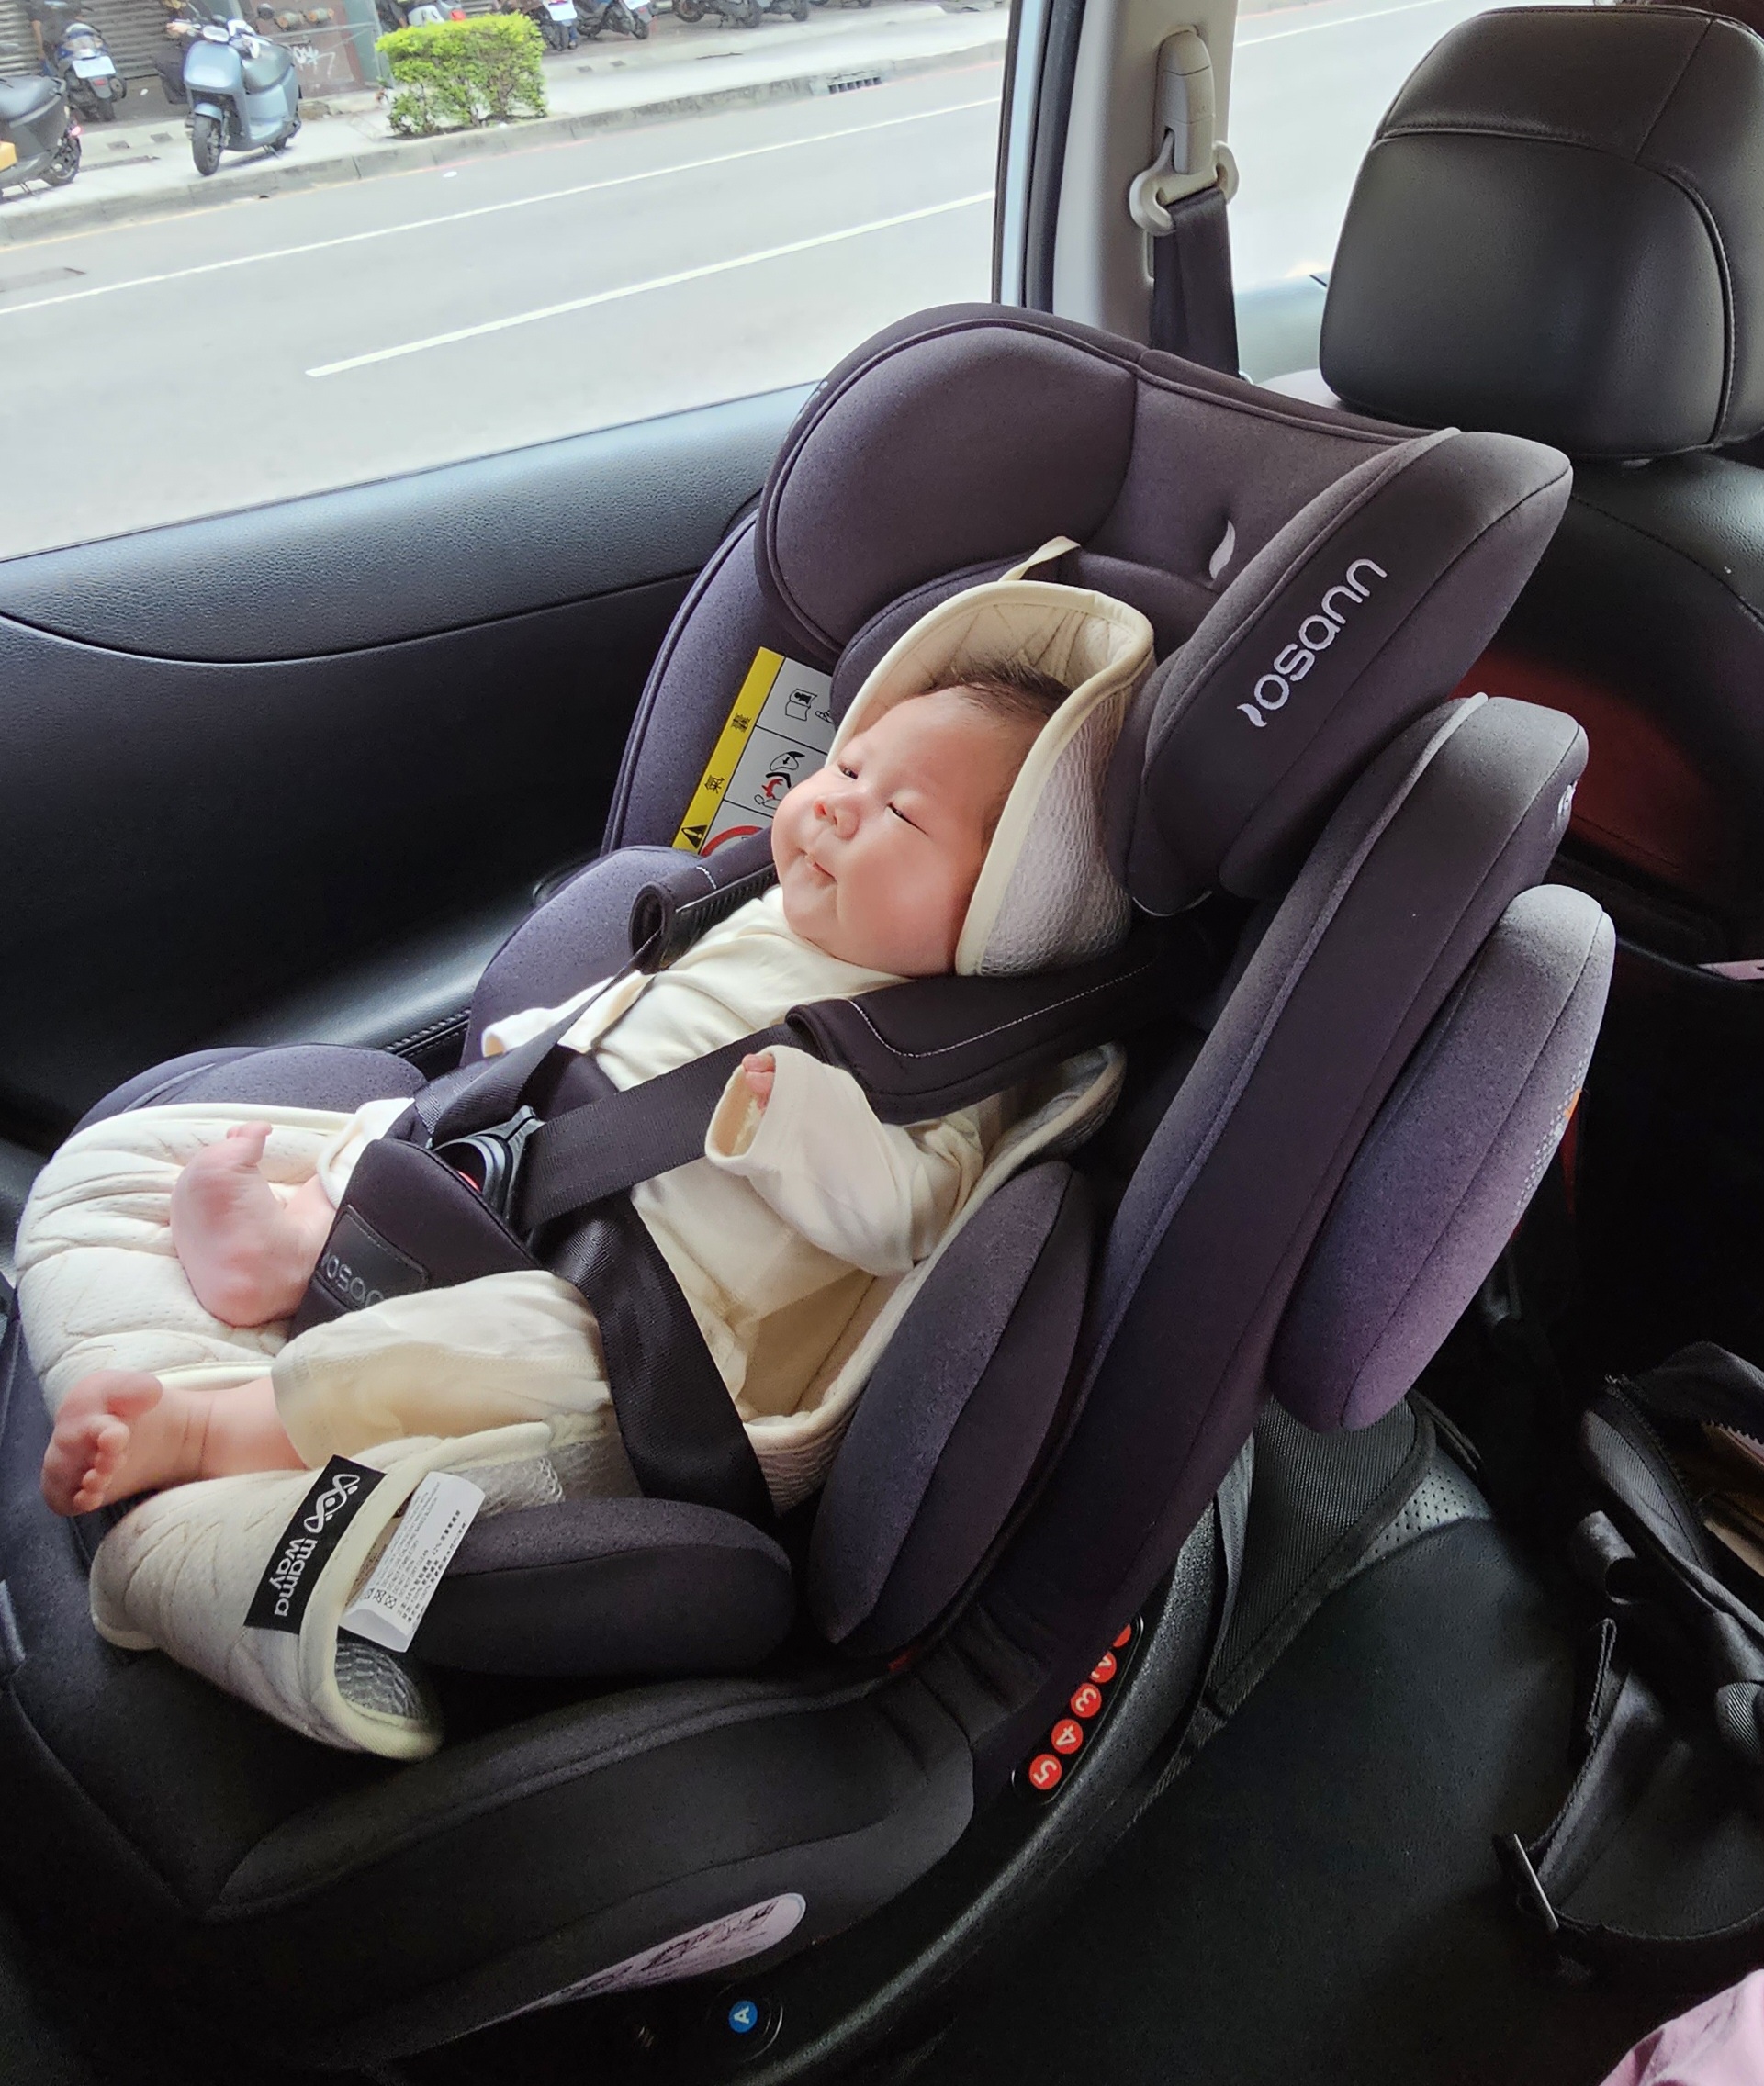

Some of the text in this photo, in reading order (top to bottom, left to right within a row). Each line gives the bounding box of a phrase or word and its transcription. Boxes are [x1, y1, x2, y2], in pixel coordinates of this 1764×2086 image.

[1253, 558, 1388, 711] osann
[269, 1537, 306, 1589] way
[274, 1538, 319, 1617] mama
[1033, 1688, 1097, 1784] 3 4 5
[733, 2005, 750, 2024] A
